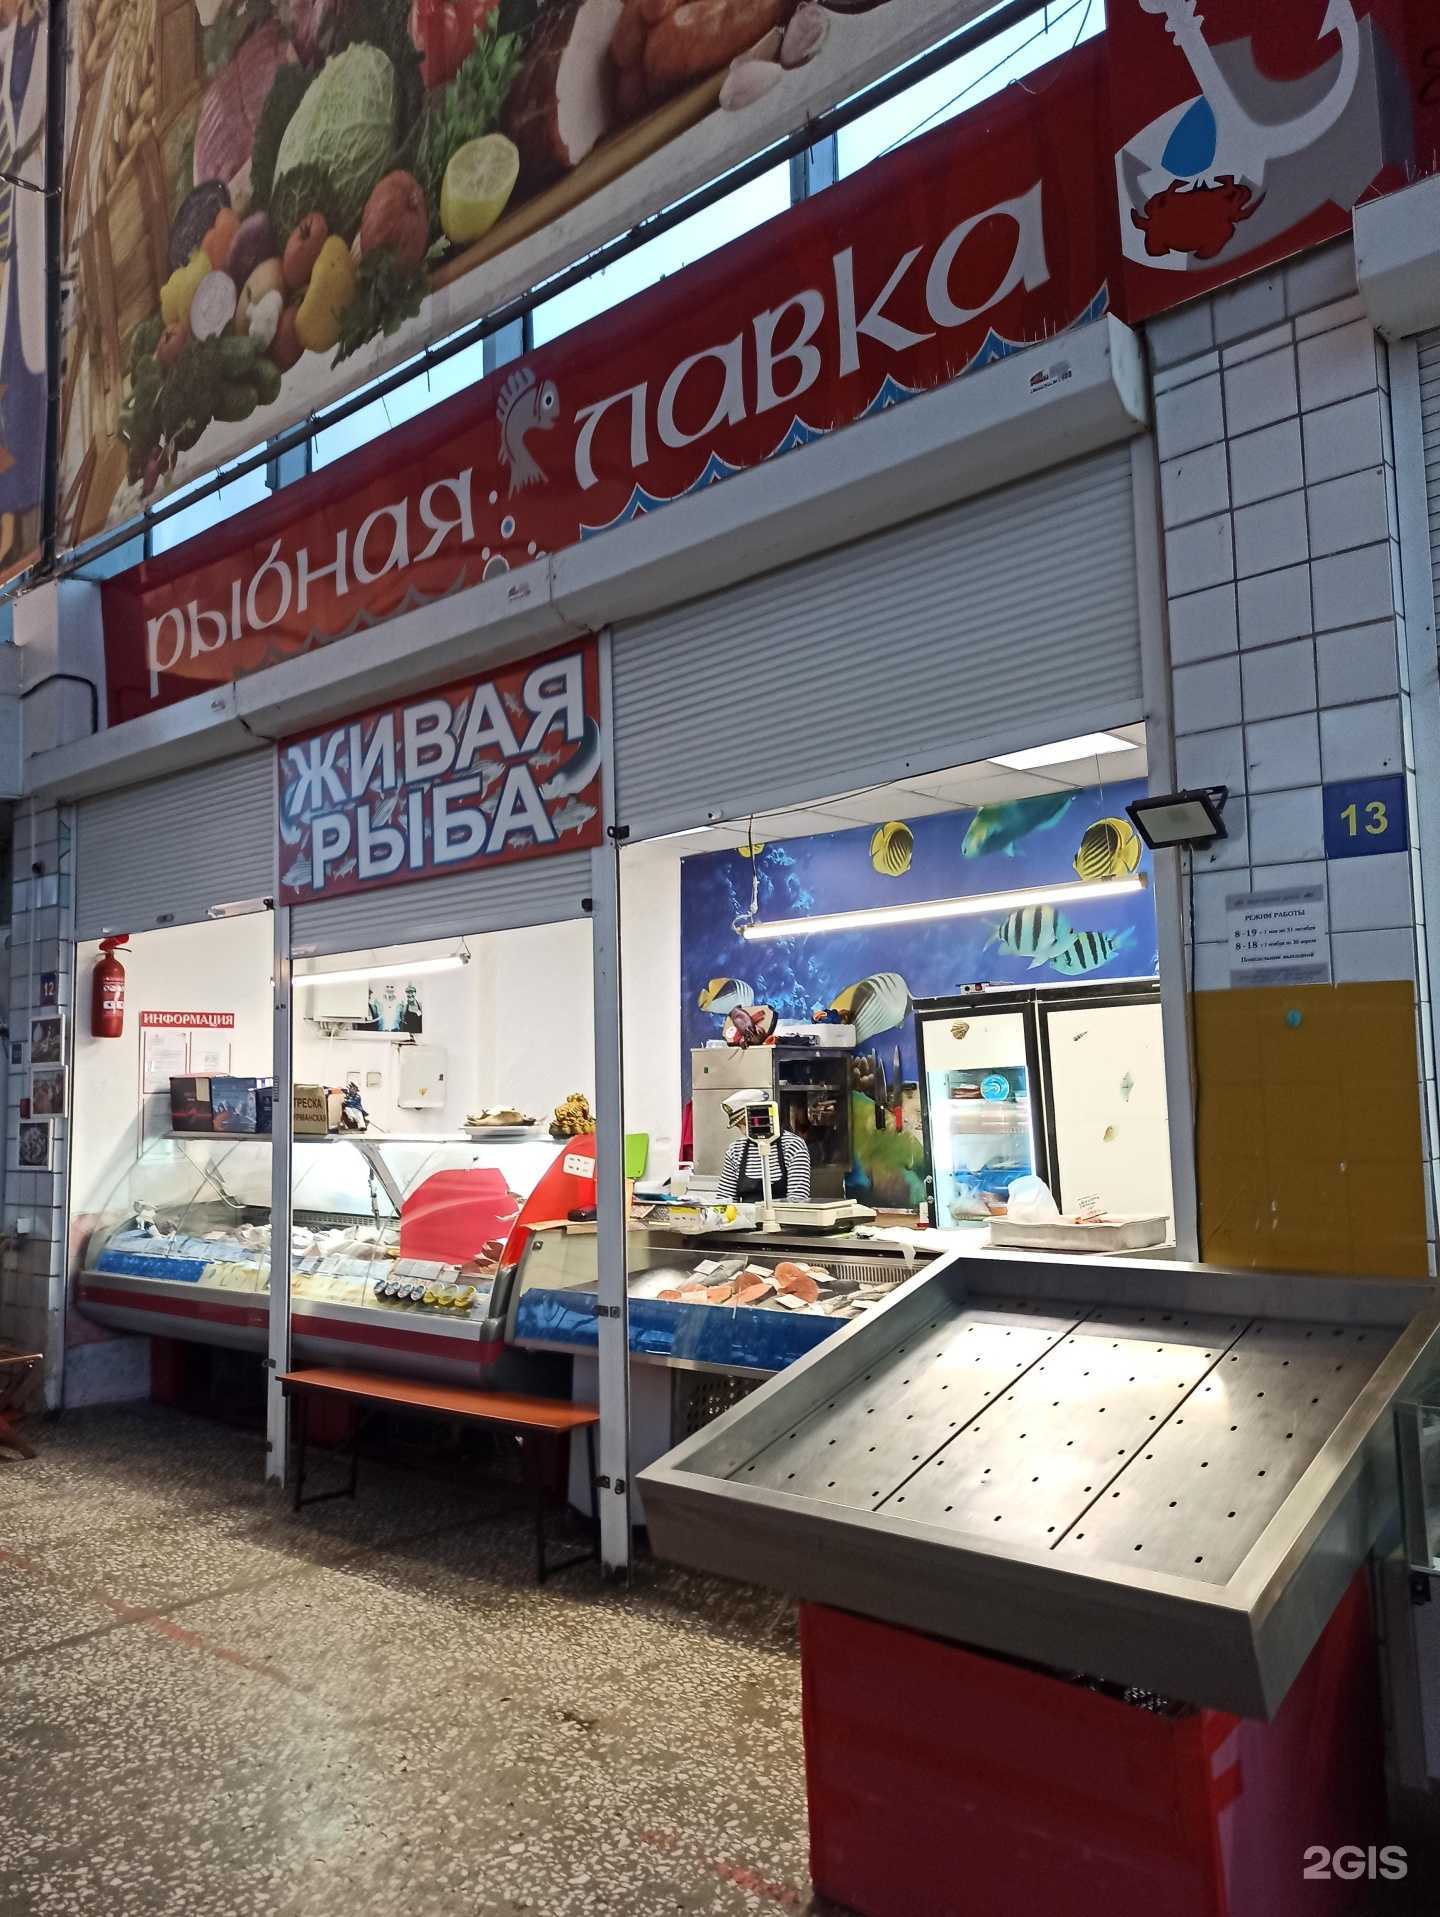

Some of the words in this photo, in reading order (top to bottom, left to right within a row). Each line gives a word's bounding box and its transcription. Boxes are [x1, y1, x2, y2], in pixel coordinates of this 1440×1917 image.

[146, 467, 476, 699] рыбная
[573, 178, 1051, 491] лавка
[287, 653, 584, 816] ЖИВАЯ
[311, 762, 556, 890] РЫБА
[1340, 801, 1389, 837] 13
[1245, 913, 1272, 921] РЕЖИМ
[1273, 910, 1305, 918] РАБОТЫ
[44, 981, 55, 997] 12
[144, 1013, 233, 1027] ИНФОРМАЦИЯ
